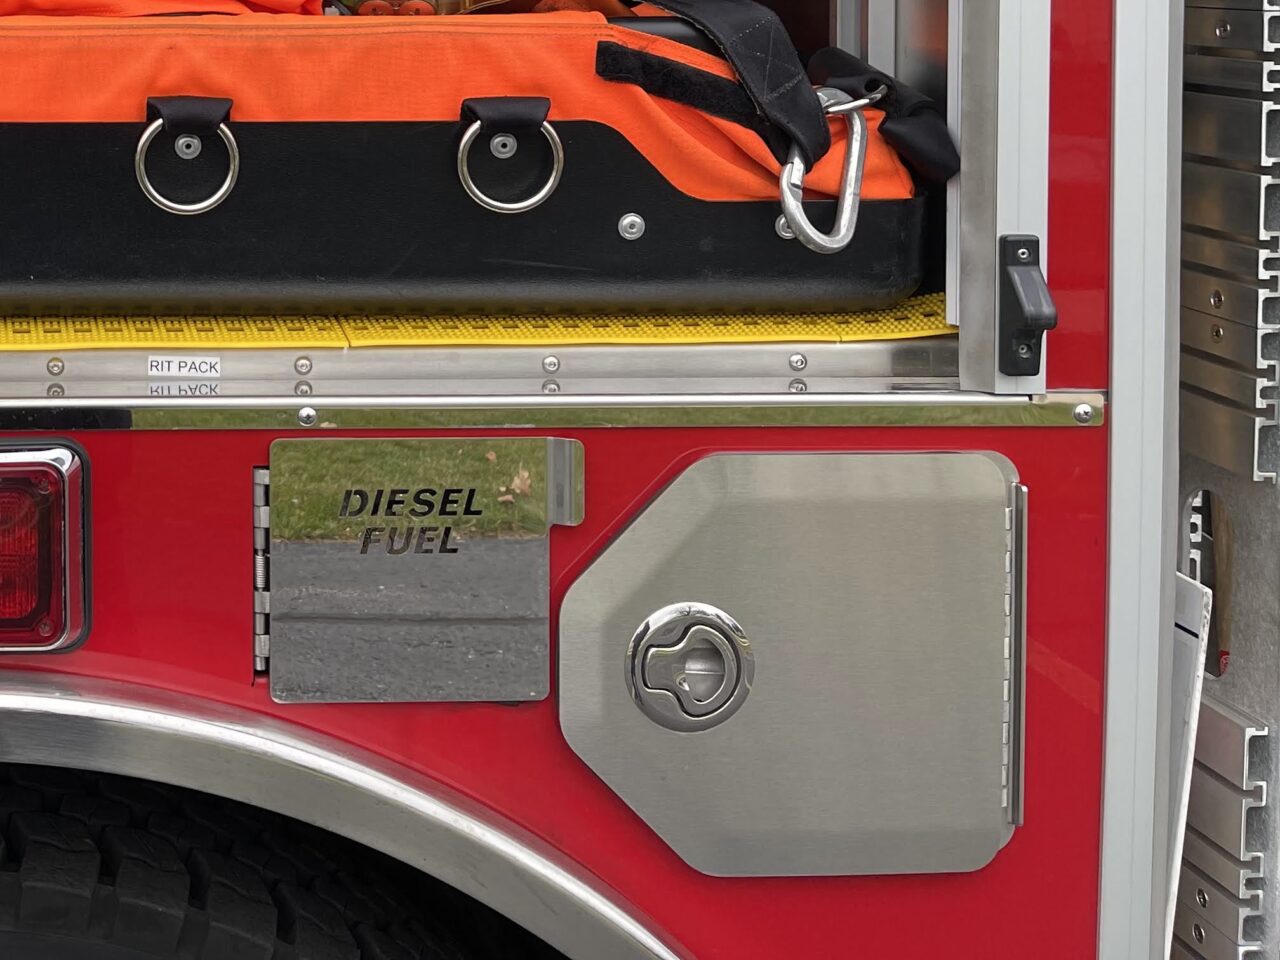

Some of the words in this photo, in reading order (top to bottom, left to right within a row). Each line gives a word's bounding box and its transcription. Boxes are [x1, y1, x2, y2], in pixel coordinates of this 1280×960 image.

[150, 360, 173, 372] RIT
[178, 360, 219, 374] PACK
[338, 487, 484, 518] DIESEL
[359, 526, 459, 555] FUEL
